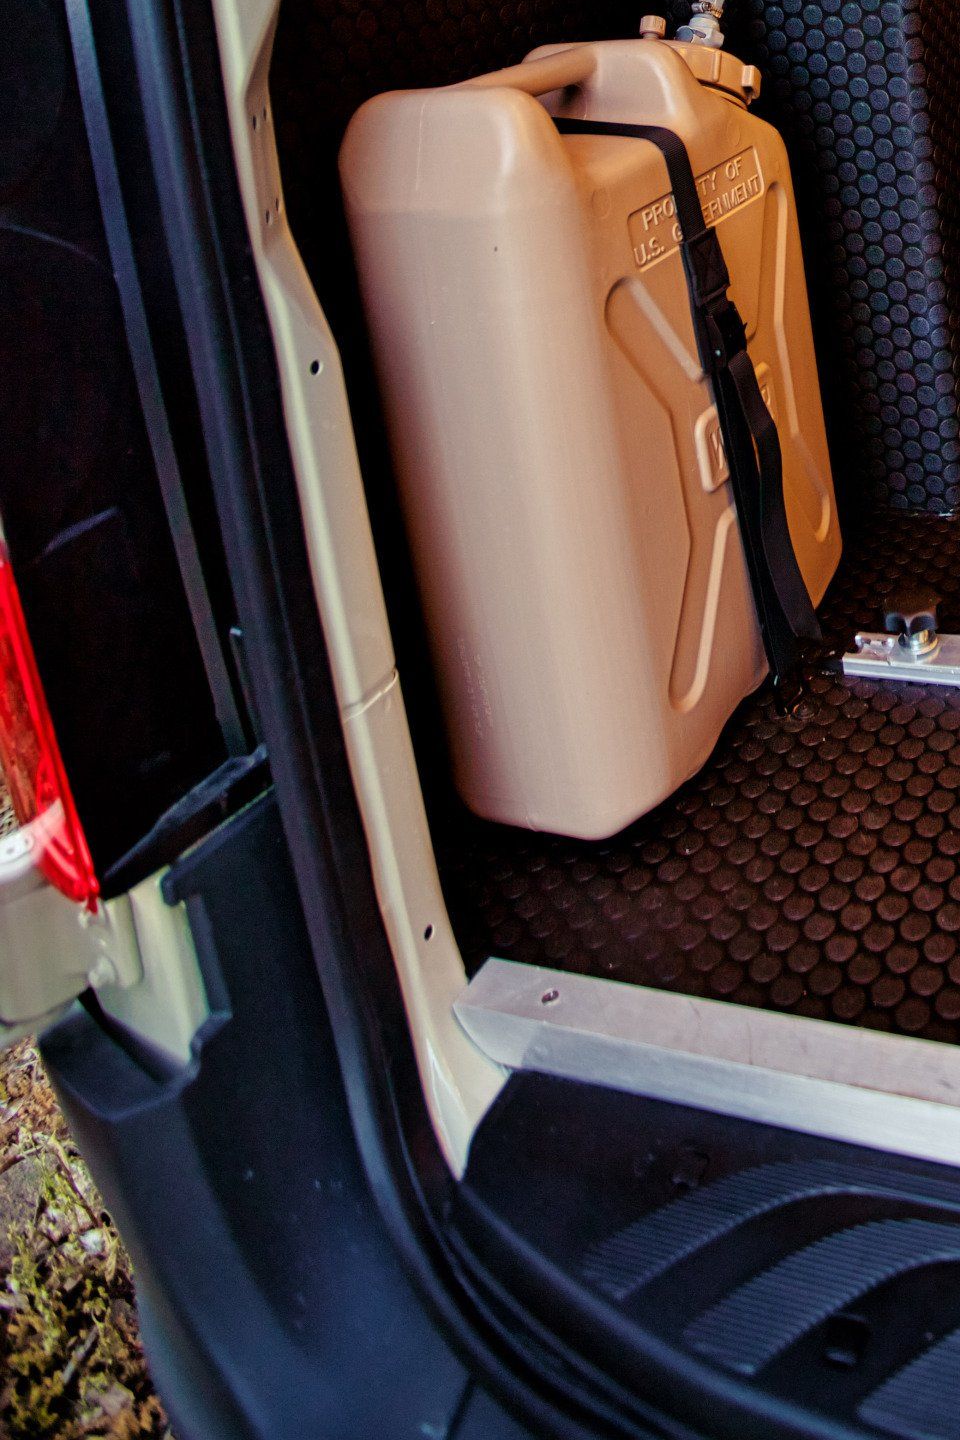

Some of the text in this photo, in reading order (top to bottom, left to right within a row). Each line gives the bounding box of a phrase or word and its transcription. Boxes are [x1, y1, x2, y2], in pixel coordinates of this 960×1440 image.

[633, 174, 760, 266] U.S. GERNMENT
[641, 156, 742, 231] PROTY OF
